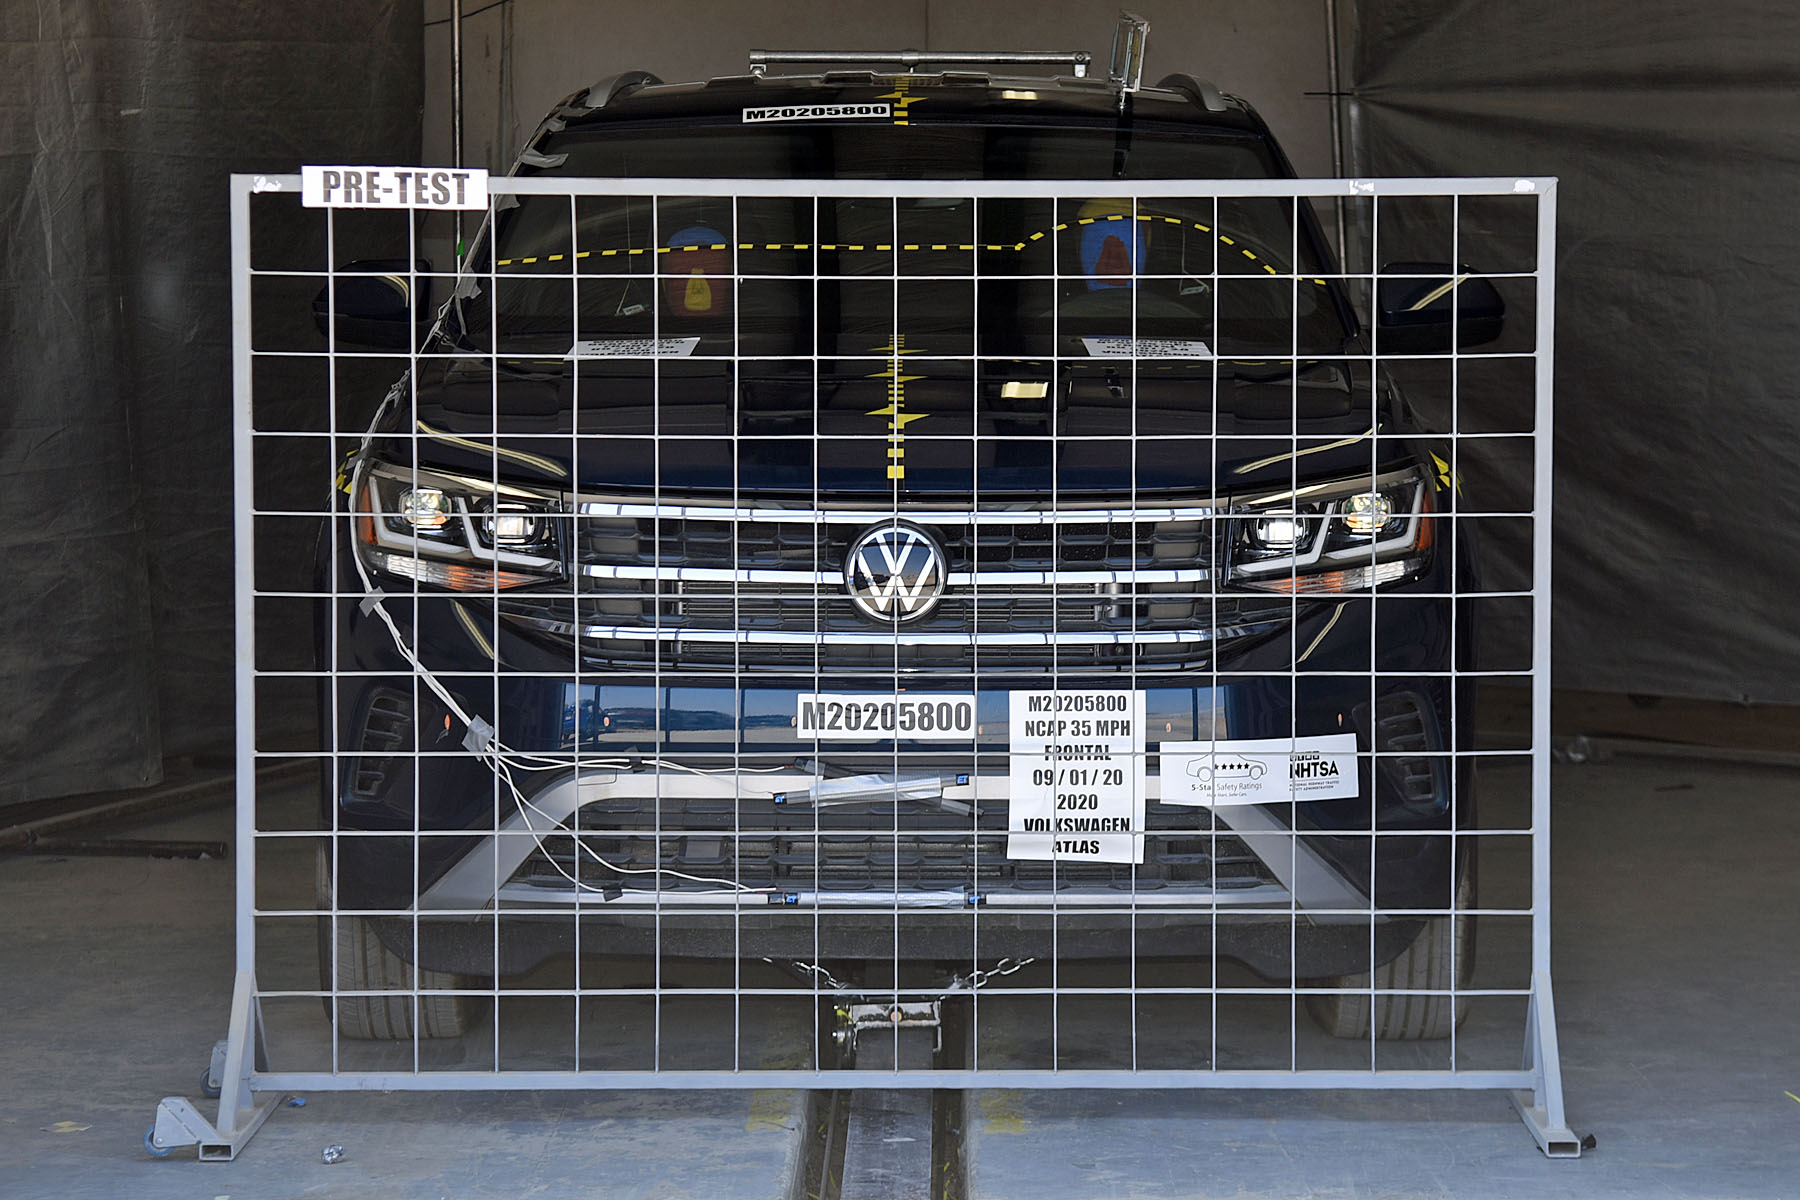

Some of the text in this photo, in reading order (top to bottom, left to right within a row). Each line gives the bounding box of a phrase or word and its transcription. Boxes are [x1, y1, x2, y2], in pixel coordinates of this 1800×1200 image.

[746, 105, 887, 120] M20205800
[322, 170, 470, 205] PRE-TEST
[1028, 695, 1127, 712] M20205800
[802, 701, 972, 731] M20205800
[1025, 720, 1131, 737] NCAP 35 MPH
[1044, 744, 1112, 761] FRONTAL
[1289, 760, 1339, 779] NHTSA
[1191, 782, 1263, 792] 5-Sta Safety Ratings
[1057, 794, 1098, 810] 2020
[1024, 817, 1130, 833] VOLKSWAGEN
[1051, 840, 1100, 854] ATLAS
